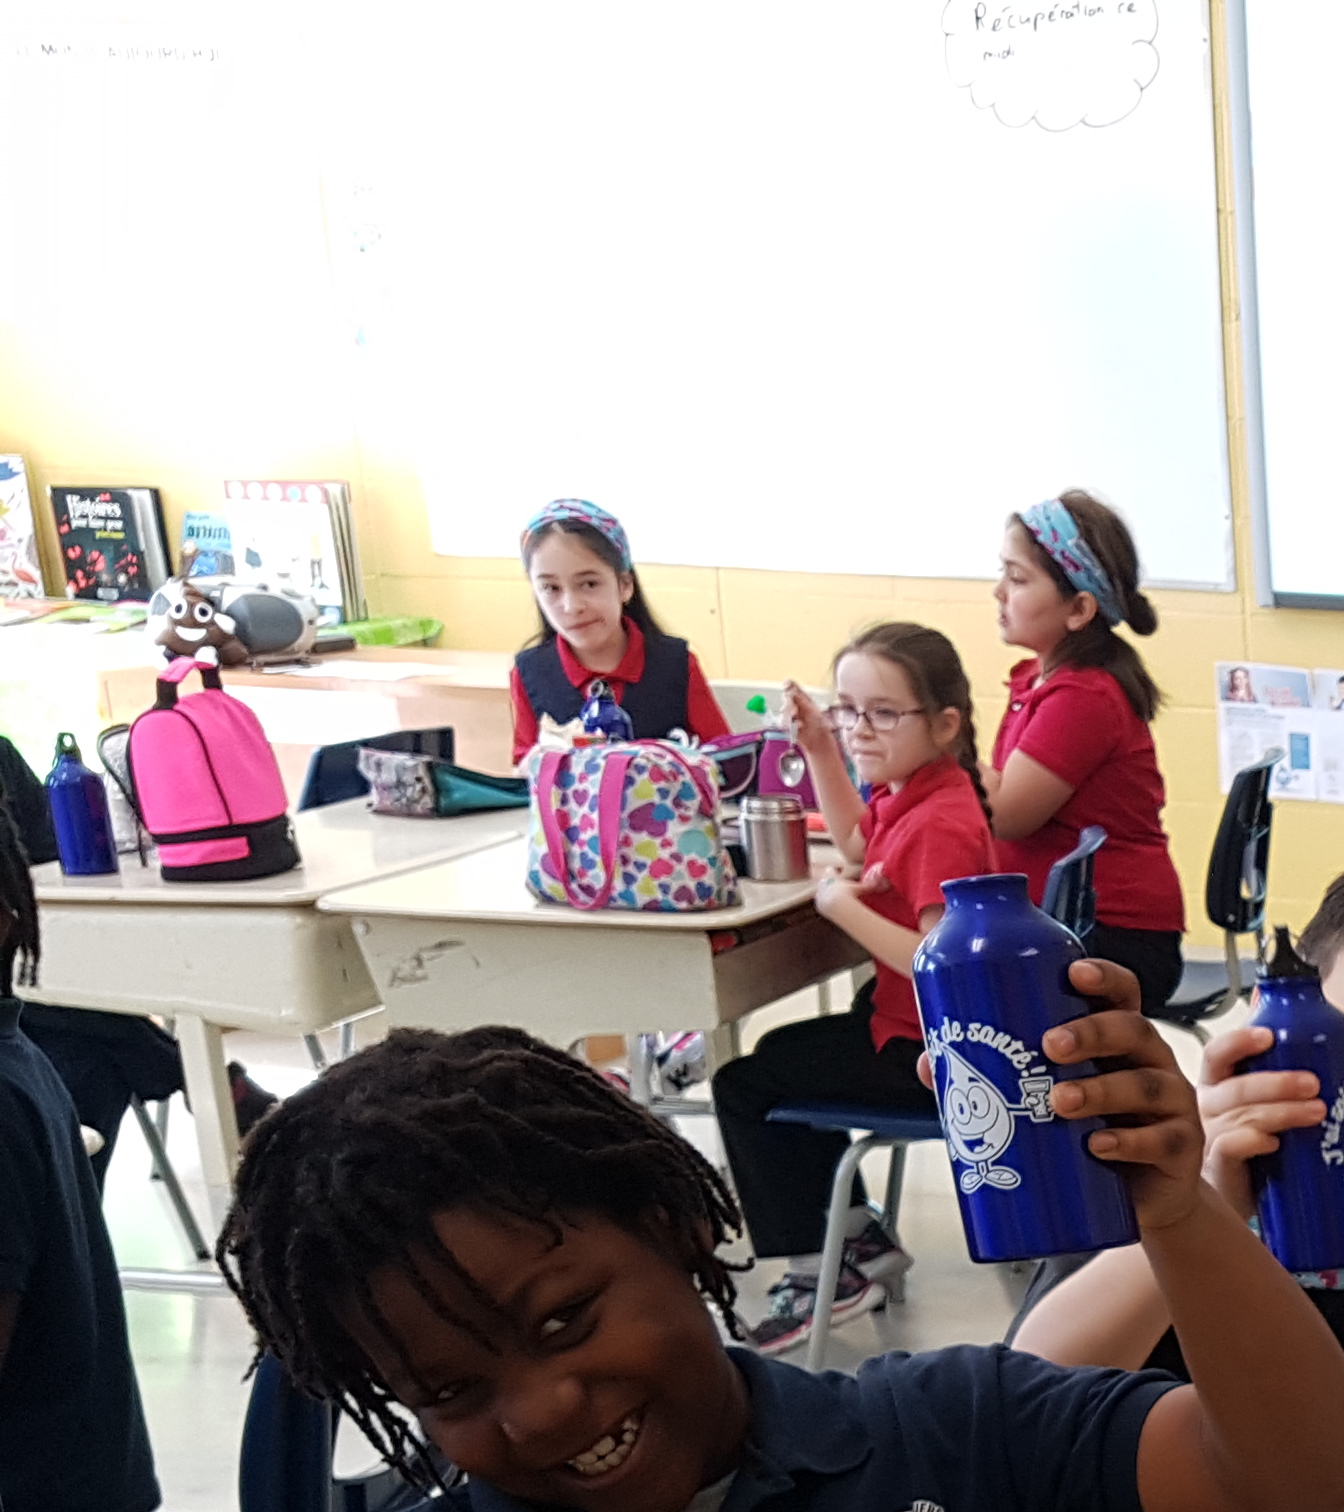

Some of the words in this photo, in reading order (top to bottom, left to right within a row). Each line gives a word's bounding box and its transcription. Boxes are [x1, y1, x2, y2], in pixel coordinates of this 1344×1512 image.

[941, 1016, 965, 1043] de
[966, 1022, 1047, 1077] santé!
[1321, 1120, 1344, 1169] J'ai
